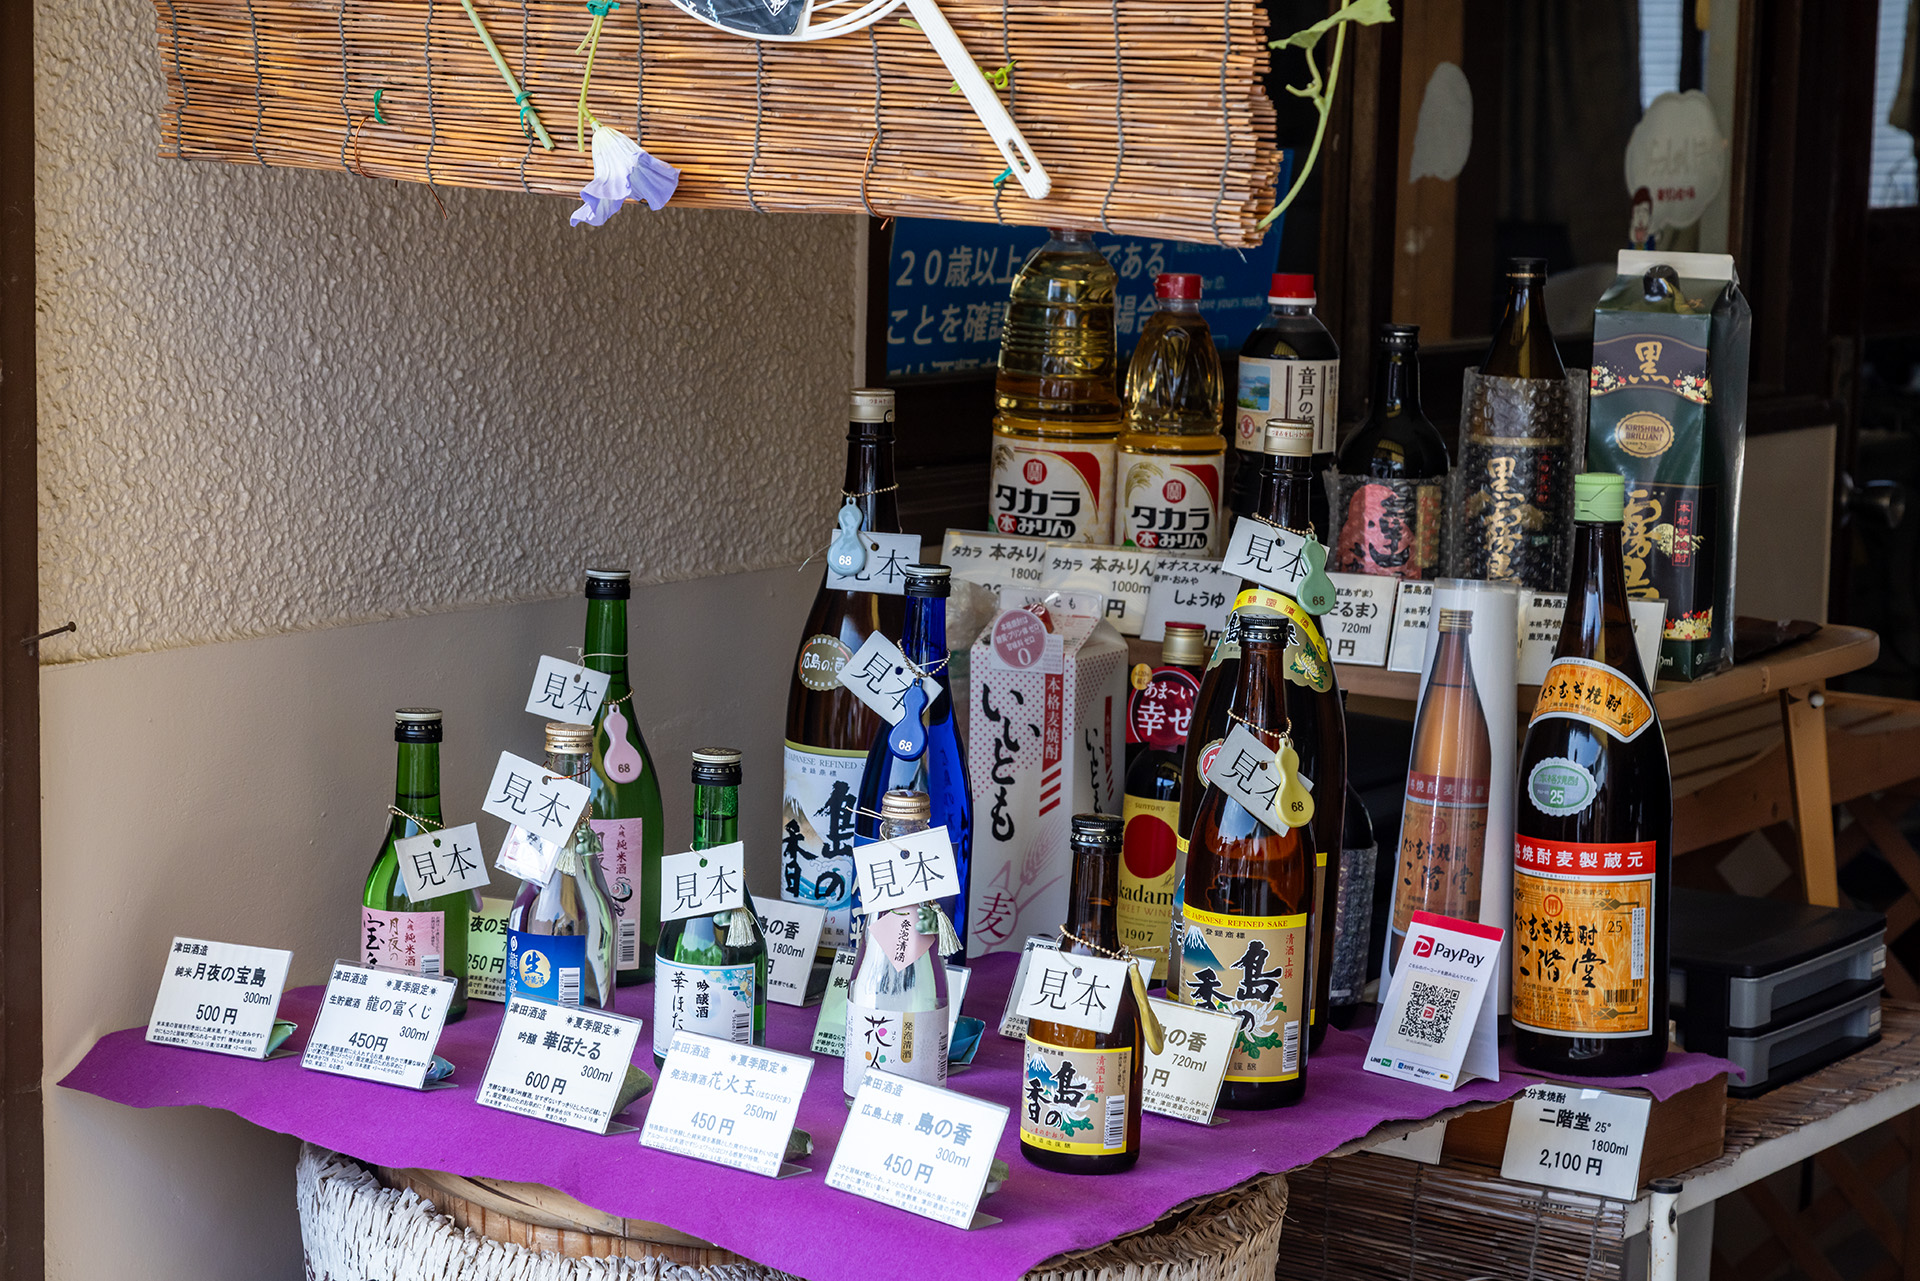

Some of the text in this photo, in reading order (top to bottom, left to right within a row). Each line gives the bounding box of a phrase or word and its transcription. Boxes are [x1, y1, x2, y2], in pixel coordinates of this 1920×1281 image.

[1625, 424, 1664, 434] KIRISHIMA
[995, 484, 1080, 517] タカラ
[998, 514, 1074, 537] 本みりん
[1132, 506, 1209, 531] タカラ
[1137, 531, 1206, 549] 本みりん
[838, 555, 851, 566] 68
[952, 543, 1046, 562] タカラ 本みり
[1237, 533, 1309, 582] 見本
[1052, 555, 1153, 576] タカラ 本みりん
[1174, 589, 1226, 608] しょうゆ
[1312, 595, 1325, 606] 68
[1341, 622, 1371, 634] 720ml
[850, 651, 912, 710] 見本
[535, 671, 598, 716] 見本
[1045, 676, 1061, 760] 本格麦焼酎
[1137, 700, 1193, 737] 幸せ
[898, 739, 912, 752] 68
[618, 763, 631, 773] 68
[819, 759, 858, 770] REFINED
[1220, 748, 1281, 811] 見本
[492, 771, 571, 828] 見本
[1291, 801, 1304, 811] 68
[1550, 789, 1564, 804] 25
[413, 844, 477, 890] 見本
[615, 839, 628, 874] 純米酒
[868, 851, 945, 903] 見本
[671, 865, 738, 914] 見本
[972, 893, 1014, 938] 麦
[1191, 910, 1288, 928] JAPANESE REFINED SAKE
[1608, 920, 1623, 933] 25
[1125, 928, 1154, 942] 1907
[1205, 928, 1246, 939] 登録商標
[173, 941, 209, 956] 津田酒造
[404, 932, 416, 966] 純米酒
[772, 942, 805, 958] 1800ml
[1284, 933, 1295, 979] 清酒上撰
[1434, 943, 1485, 968] PayPay
[1520, 945, 1606, 989] 二階堂
[332, 969, 430, 996] 津田酒造 夏季限定
[1030, 967, 1111, 1017] 見本
[242, 991, 272, 1005] 300ml
[328, 994, 432, 1020] 生貯蔵酒 龍の富くじ
[695, 980, 710, 1019] 吟醸酒
[509, 1002, 613, 1036] 津田酒造 夏季限定
[348, 1031, 389, 1053] 450円
[399, 1026, 430, 1041] 300ml
[517, 1030, 601, 1061] 吟醸 華ほたる
[902, 1021, 914, 1059] 発泡清酒
[669, 1039, 780, 1074] 津田酒造 夏季限定
[1171, 1053, 1207, 1072] 720ml
[580, 1064, 613, 1083] 300ml
[670, 1068, 708, 1086] 発泡清酒
[707, 1070, 756, 1097] 花火玉
[861, 1075, 904, 1097] 津田酒造
[743, 1103, 778, 1122] 250ml
[861, 1103, 973, 1146] 広島上撰 島の香
[1539, 1107, 1591, 1132] 二階堂
[935, 1146, 971, 1168] 300ml
[1591, 1138, 1629, 1156] 1800ml
